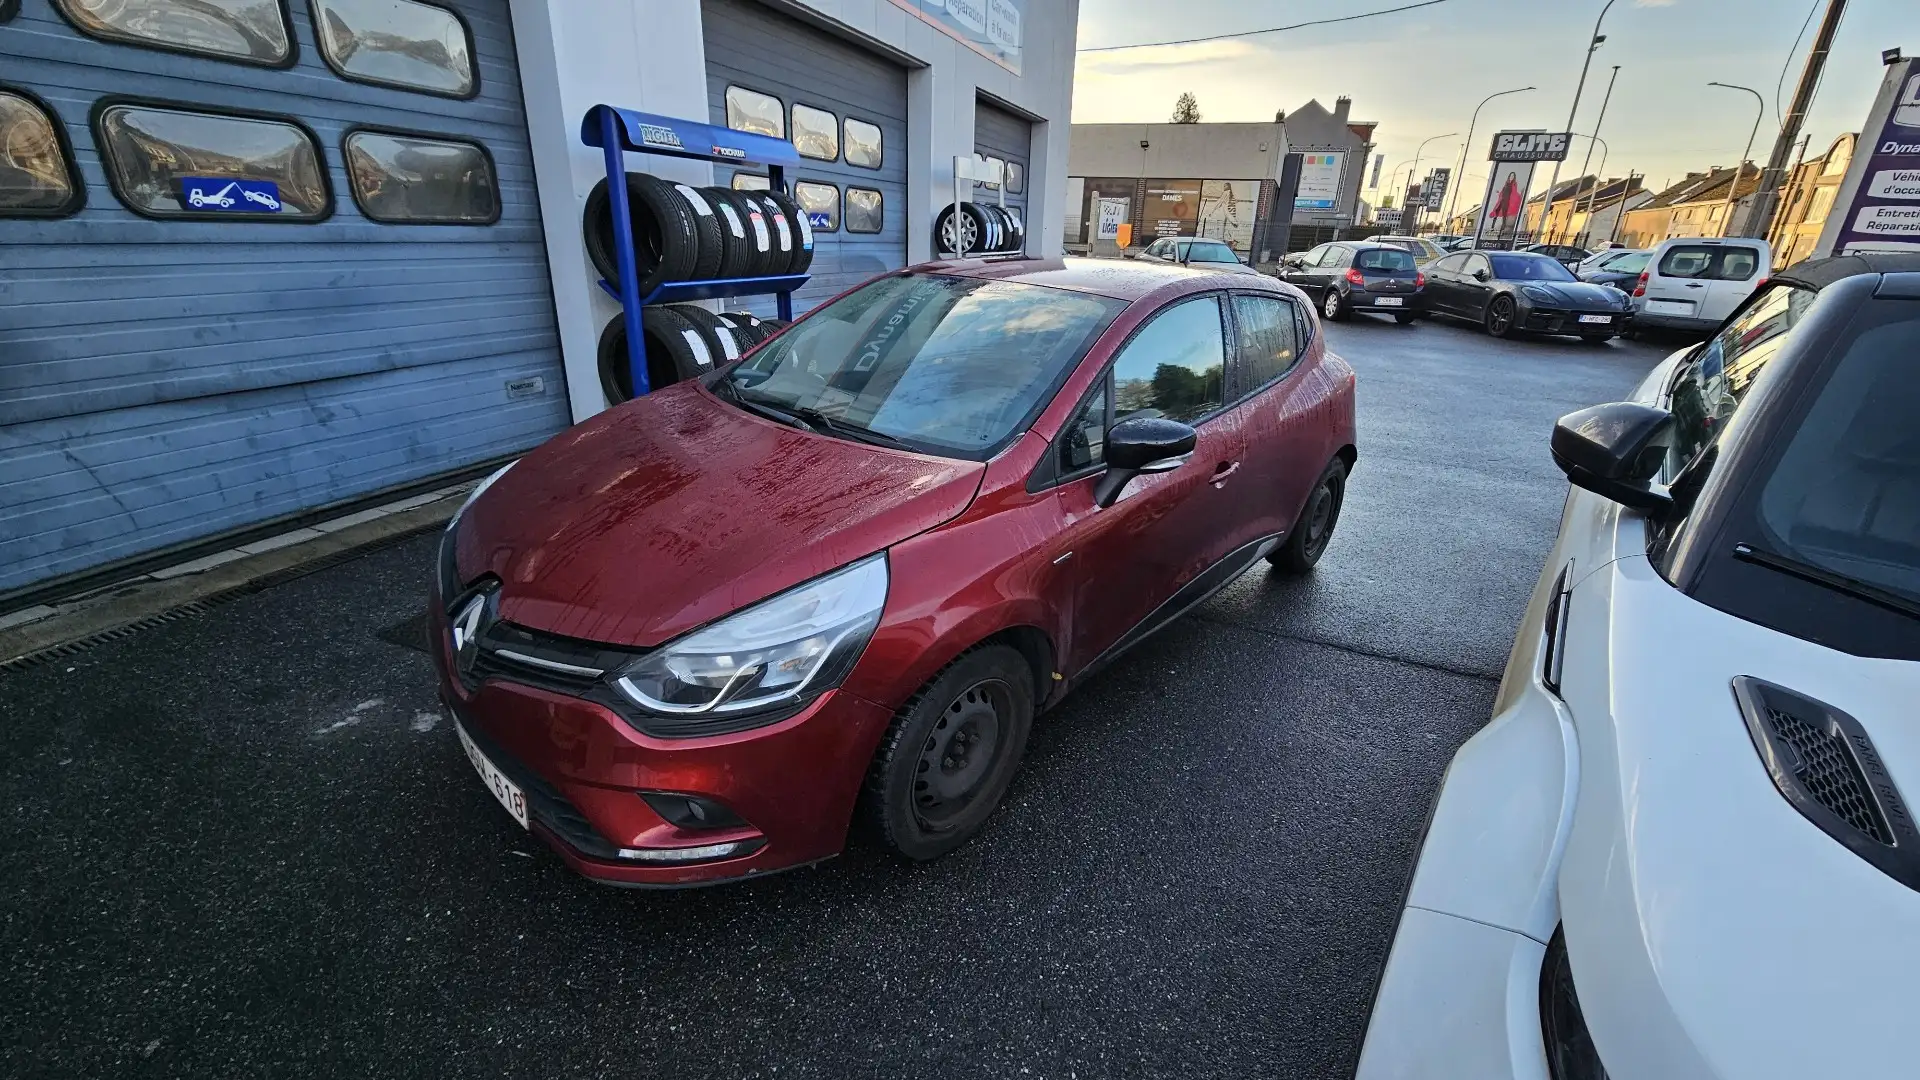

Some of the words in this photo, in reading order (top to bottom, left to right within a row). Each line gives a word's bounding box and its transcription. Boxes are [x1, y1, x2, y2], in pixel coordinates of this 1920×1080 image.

[1495, 134, 1567, 152] ELITE
[1494, 151, 1563, 159] CHAUSSURES
[1428, 173, 1446, 207] ELITE
[1102, 218, 1118, 234] LIGIE
